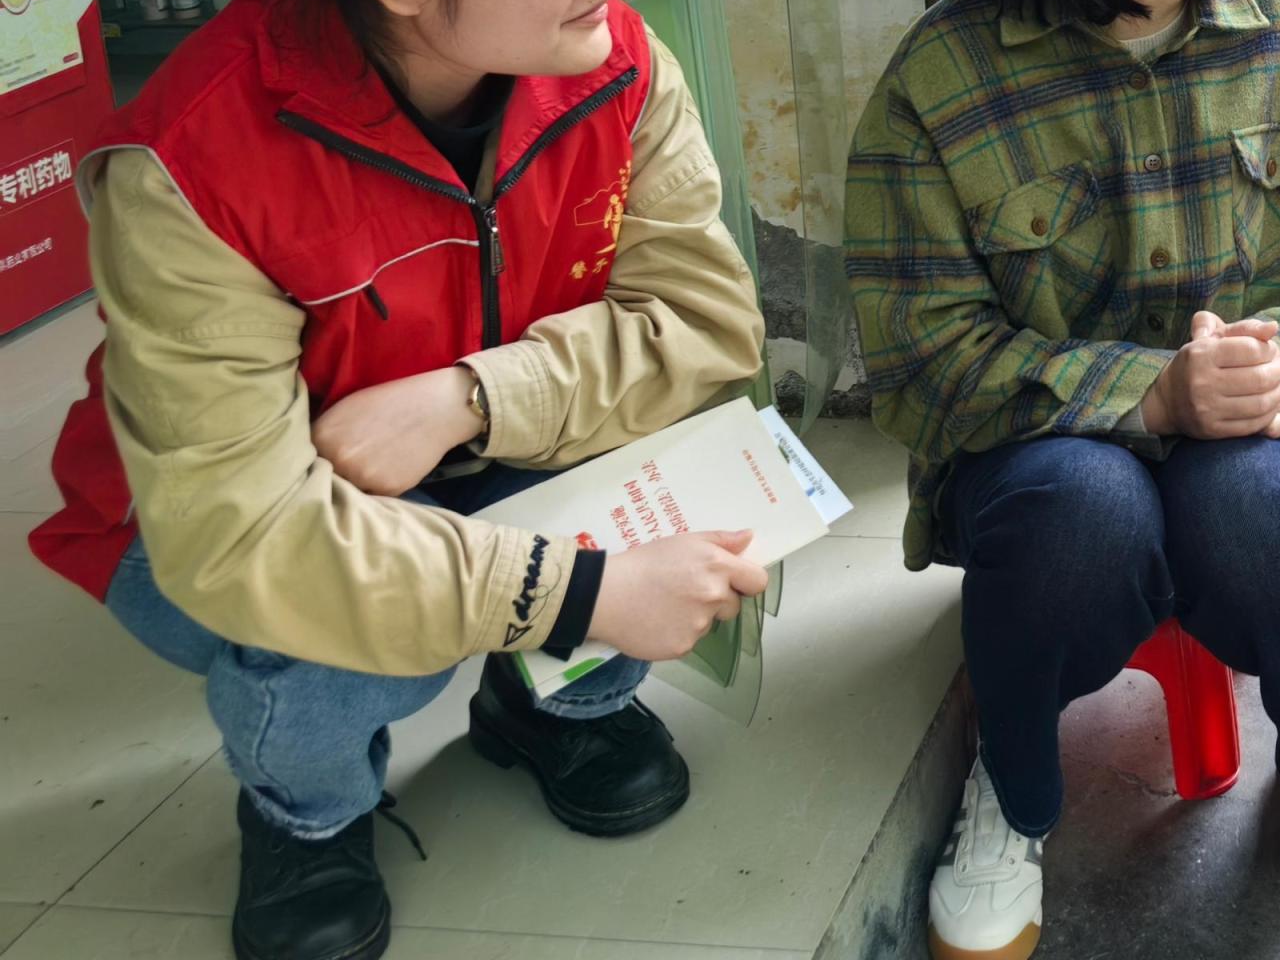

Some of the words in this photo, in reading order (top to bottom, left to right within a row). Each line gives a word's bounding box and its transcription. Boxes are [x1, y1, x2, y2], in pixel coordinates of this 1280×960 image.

[623, 478, 662, 540] 人民共和国
